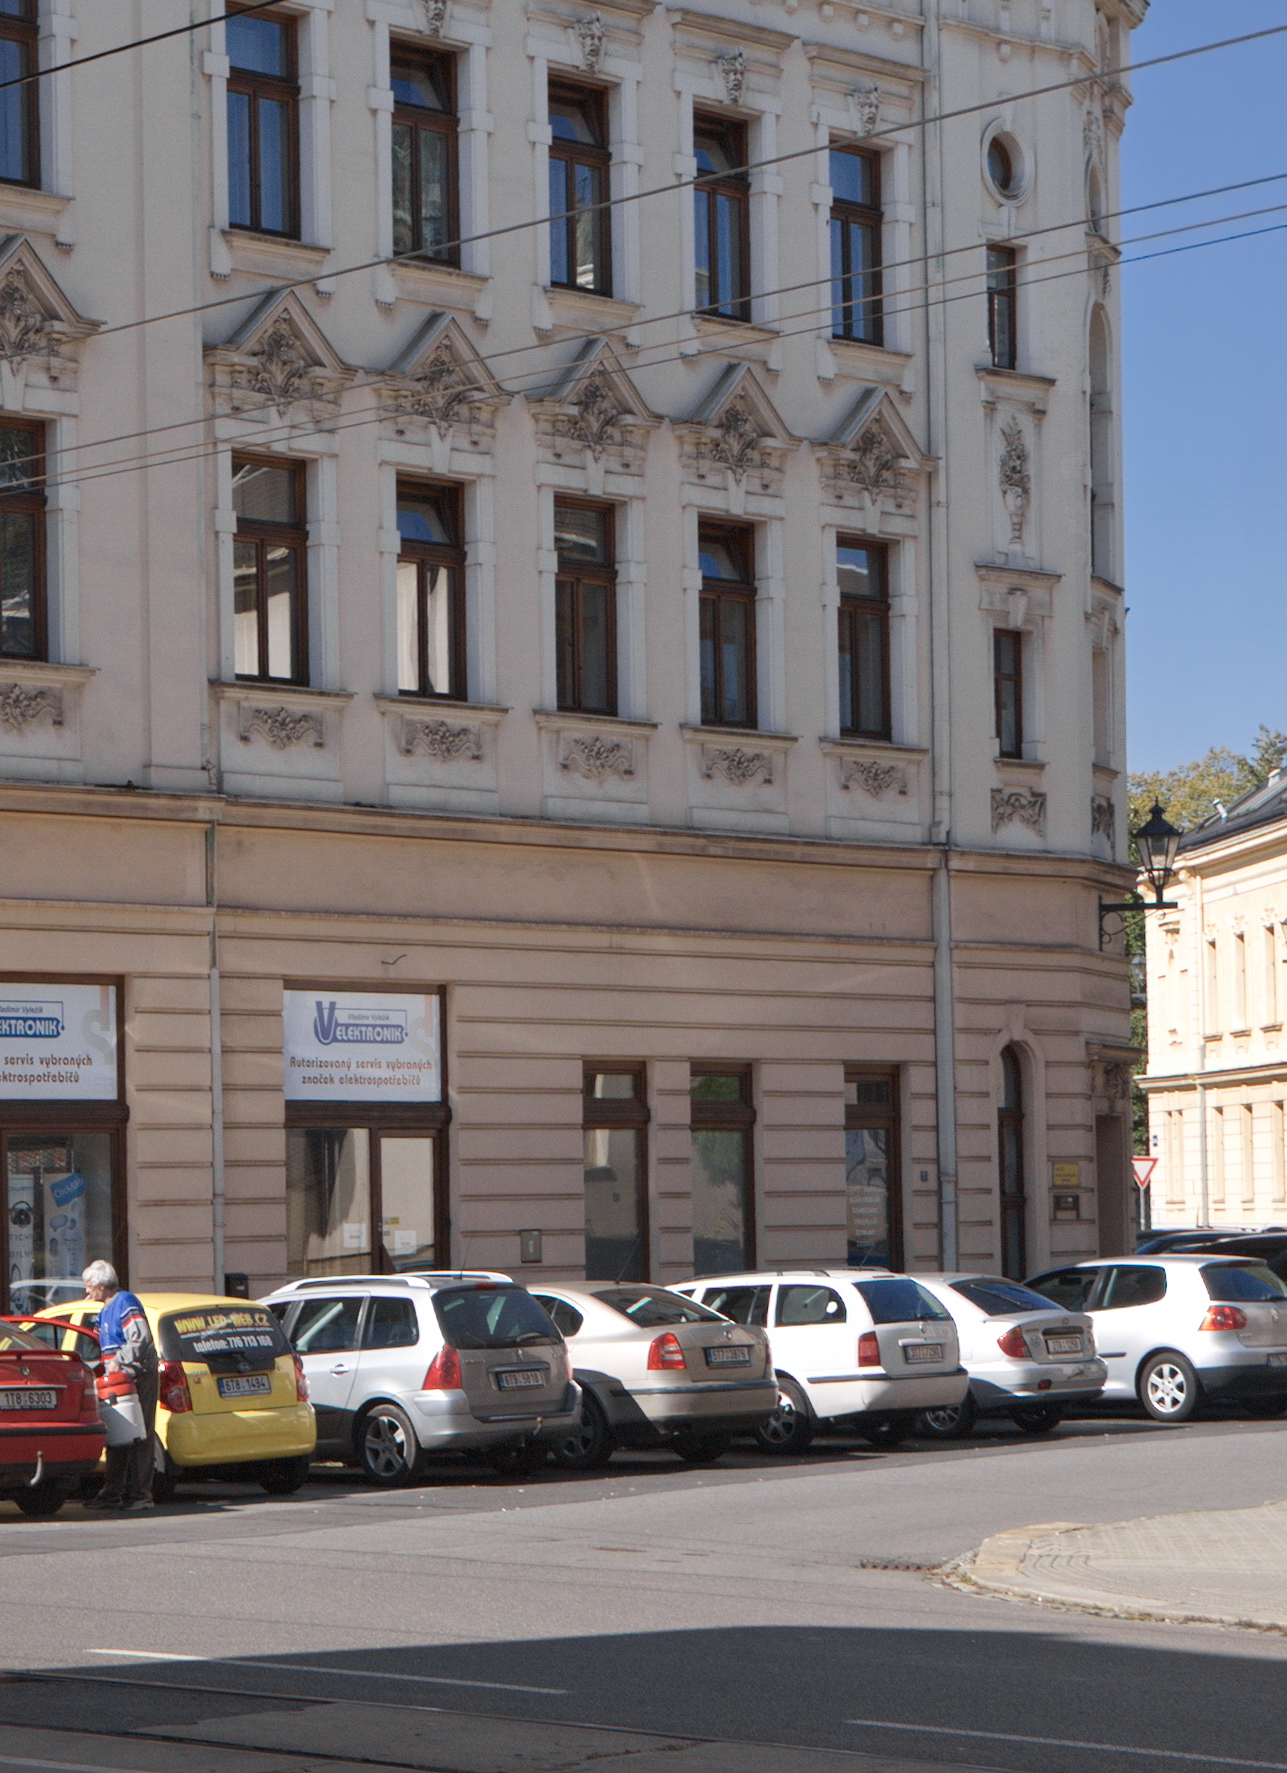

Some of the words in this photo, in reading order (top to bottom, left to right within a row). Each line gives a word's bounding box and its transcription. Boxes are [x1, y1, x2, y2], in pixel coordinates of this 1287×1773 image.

[5, 1054, 34, 1066] servis
[39, 1054, 93, 1069] vybraných
[290, 1056, 352, 1071] Autorizovaný
[355, 1058, 382, 1069] servis
[386, 1059, 433, 1073] vybraných
[302, 1074, 335, 1085] značek
[4, 1392, 22, 1405] 1T8
[28, 1392, 52, 1405] 6303
